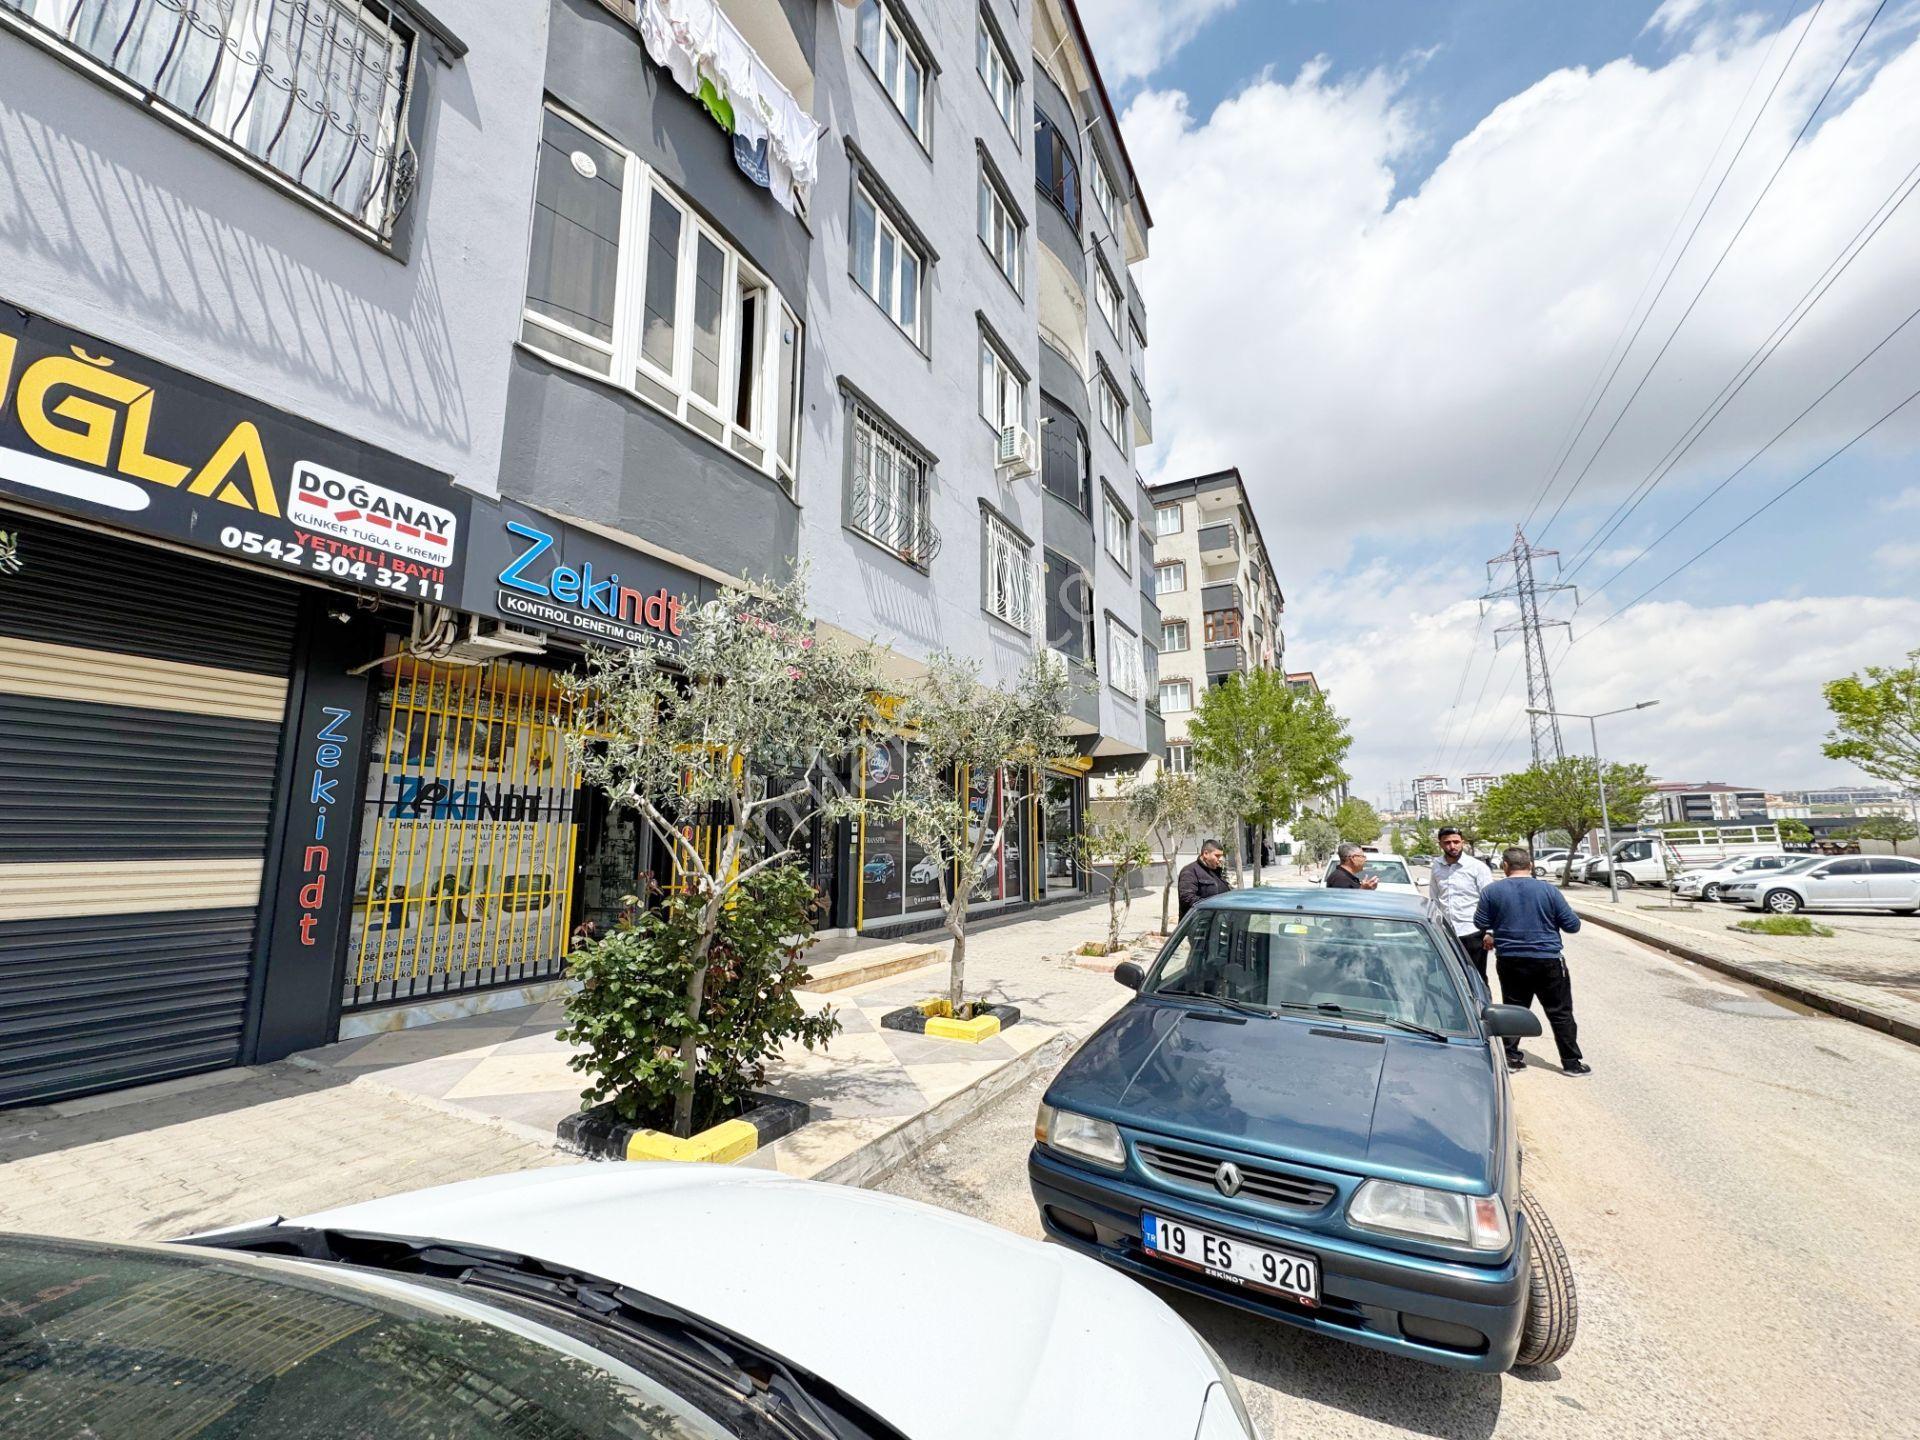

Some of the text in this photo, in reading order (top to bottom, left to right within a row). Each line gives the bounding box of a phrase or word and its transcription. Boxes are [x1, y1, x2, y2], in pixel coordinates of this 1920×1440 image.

[299, 470, 450, 535] DOĞANAY
[294, 511, 348, 535] KLİNKER
[352, 528, 390, 549] TUĞLA
[294, 529, 386, 568] YETKİLİ
[220, 526, 444, 601] 0542 304 32 11
[499, 520, 683, 637] Zekindt
[507, 597, 570, 624] KONTROL
[299, 706, 351, 946] Zekindt
[388, 821, 442, 830] THRBALI
[1146, 1232, 1156, 1242] TR
[1161, 1223, 1311, 1293] 19 ES 920
